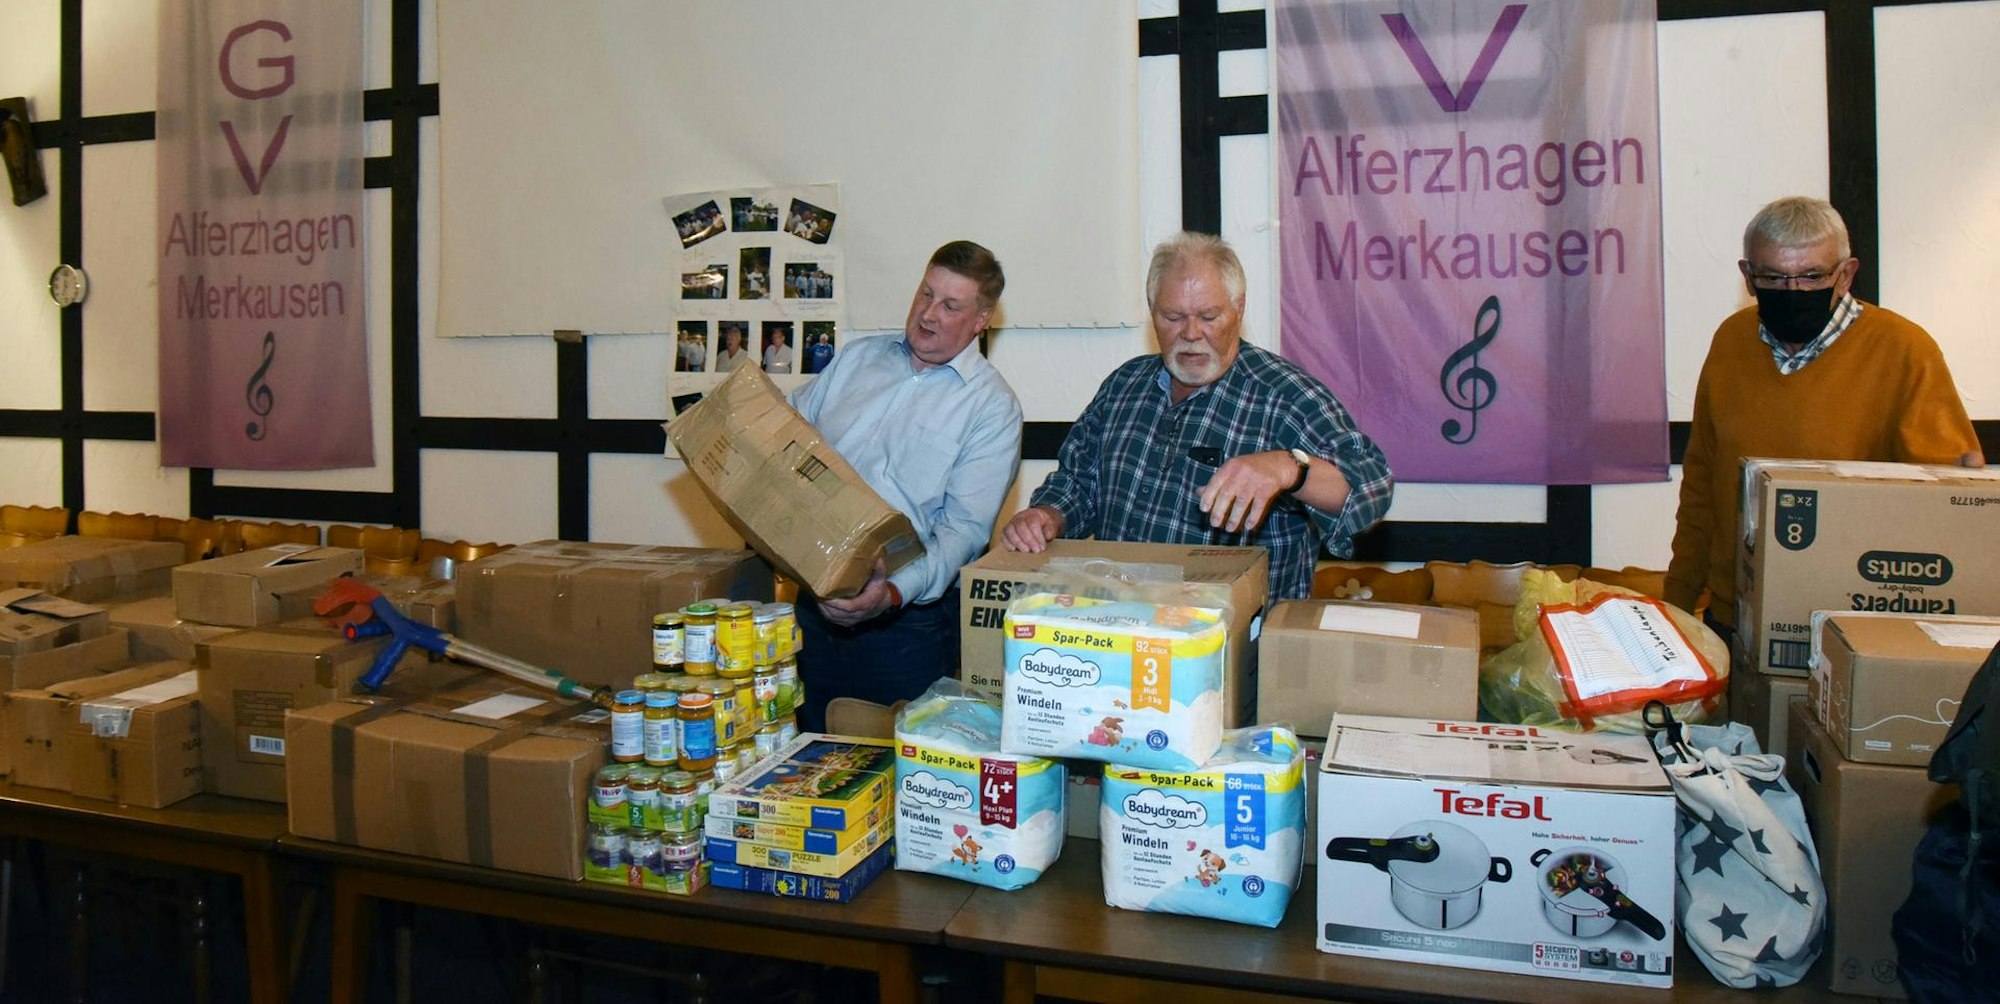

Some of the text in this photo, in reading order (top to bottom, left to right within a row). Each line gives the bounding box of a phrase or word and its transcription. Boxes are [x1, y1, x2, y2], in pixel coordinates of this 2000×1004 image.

[218, 19, 295, 101] G
[1380, 3, 1529, 113] V
[218, 114, 294, 196] V
[1293, 131, 1645, 207] Alferzhagen
[164, 210, 356, 266] Alferzhagen
[1314, 219, 1626, 282] Merkausen
[176, 274, 345, 320] Merkausen
[1787, 523, 1803, 545] 8
[1866, 558, 1943, 580] pants
[1052, 630, 1114, 649] Spar-Pack
[1135, 640, 1150, 654] 92
[1024, 659, 1092, 679] Babydream
[1142, 657, 1159, 687] 3
[970, 674, 988, 686] Sie
[1016, 693, 1063, 711] Windeln
[1427, 721, 1549, 739] Tefal
[920, 750, 975, 770] Spar-Pack
[983, 762, 996, 775] 72
[1149, 773, 1214, 788] Spar-Pack
[905, 779, 966, 803] Babydream
[760, 803, 776, 814] 300
[1127, 799, 1198, 820] Babydream
[1236, 794, 1253, 825] 5
[1432, 788, 1552, 822] Tefal
[900, 806, 941, 826] Windeln
[1121, 832, 1169, 850] Windeln
[1531, 831, 1550, 839] Hohe
[791, 852, 821, 863] PUZZLE
[824, 889, 840, 900] 200
[1423, 936, 1433, 947] 5
[1535, 944, 1578, 959] 5 SECURITY
[1544, 952, 1578, 963] SYSTEM
